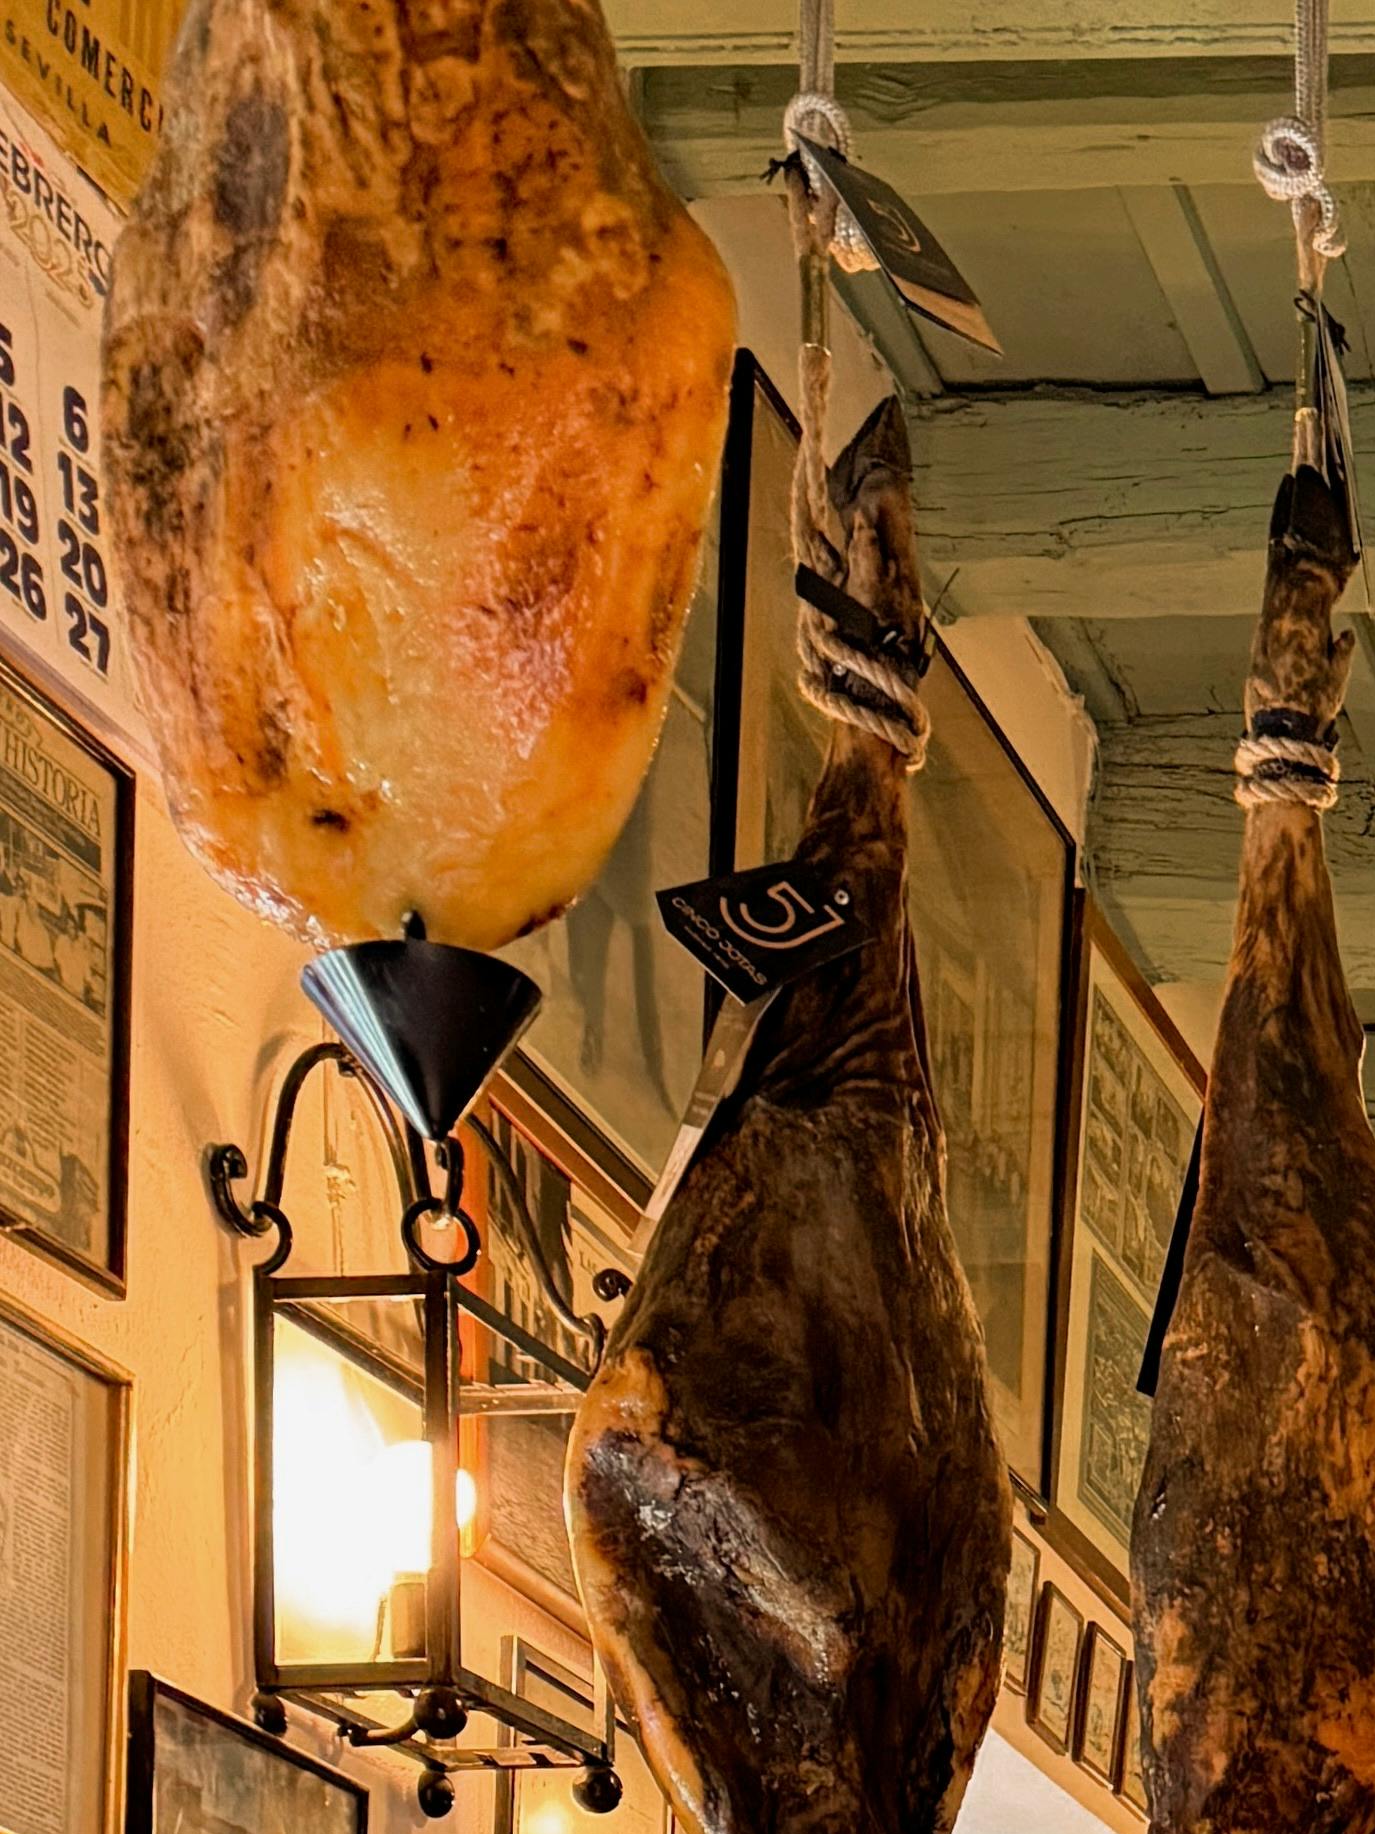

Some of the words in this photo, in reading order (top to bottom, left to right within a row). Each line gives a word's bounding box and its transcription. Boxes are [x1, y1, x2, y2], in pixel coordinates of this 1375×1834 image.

[4, 18, 111, 147] SEVILLA
[63, 385, 88, 454] 6
[58, 451, 100, 536] 13
[58, 518, 107, 608] 20
[65, 591, 111, 676] 27
[4, 723, 101, 839] HISTORIA
[719, 881, 845, 949] 5J
